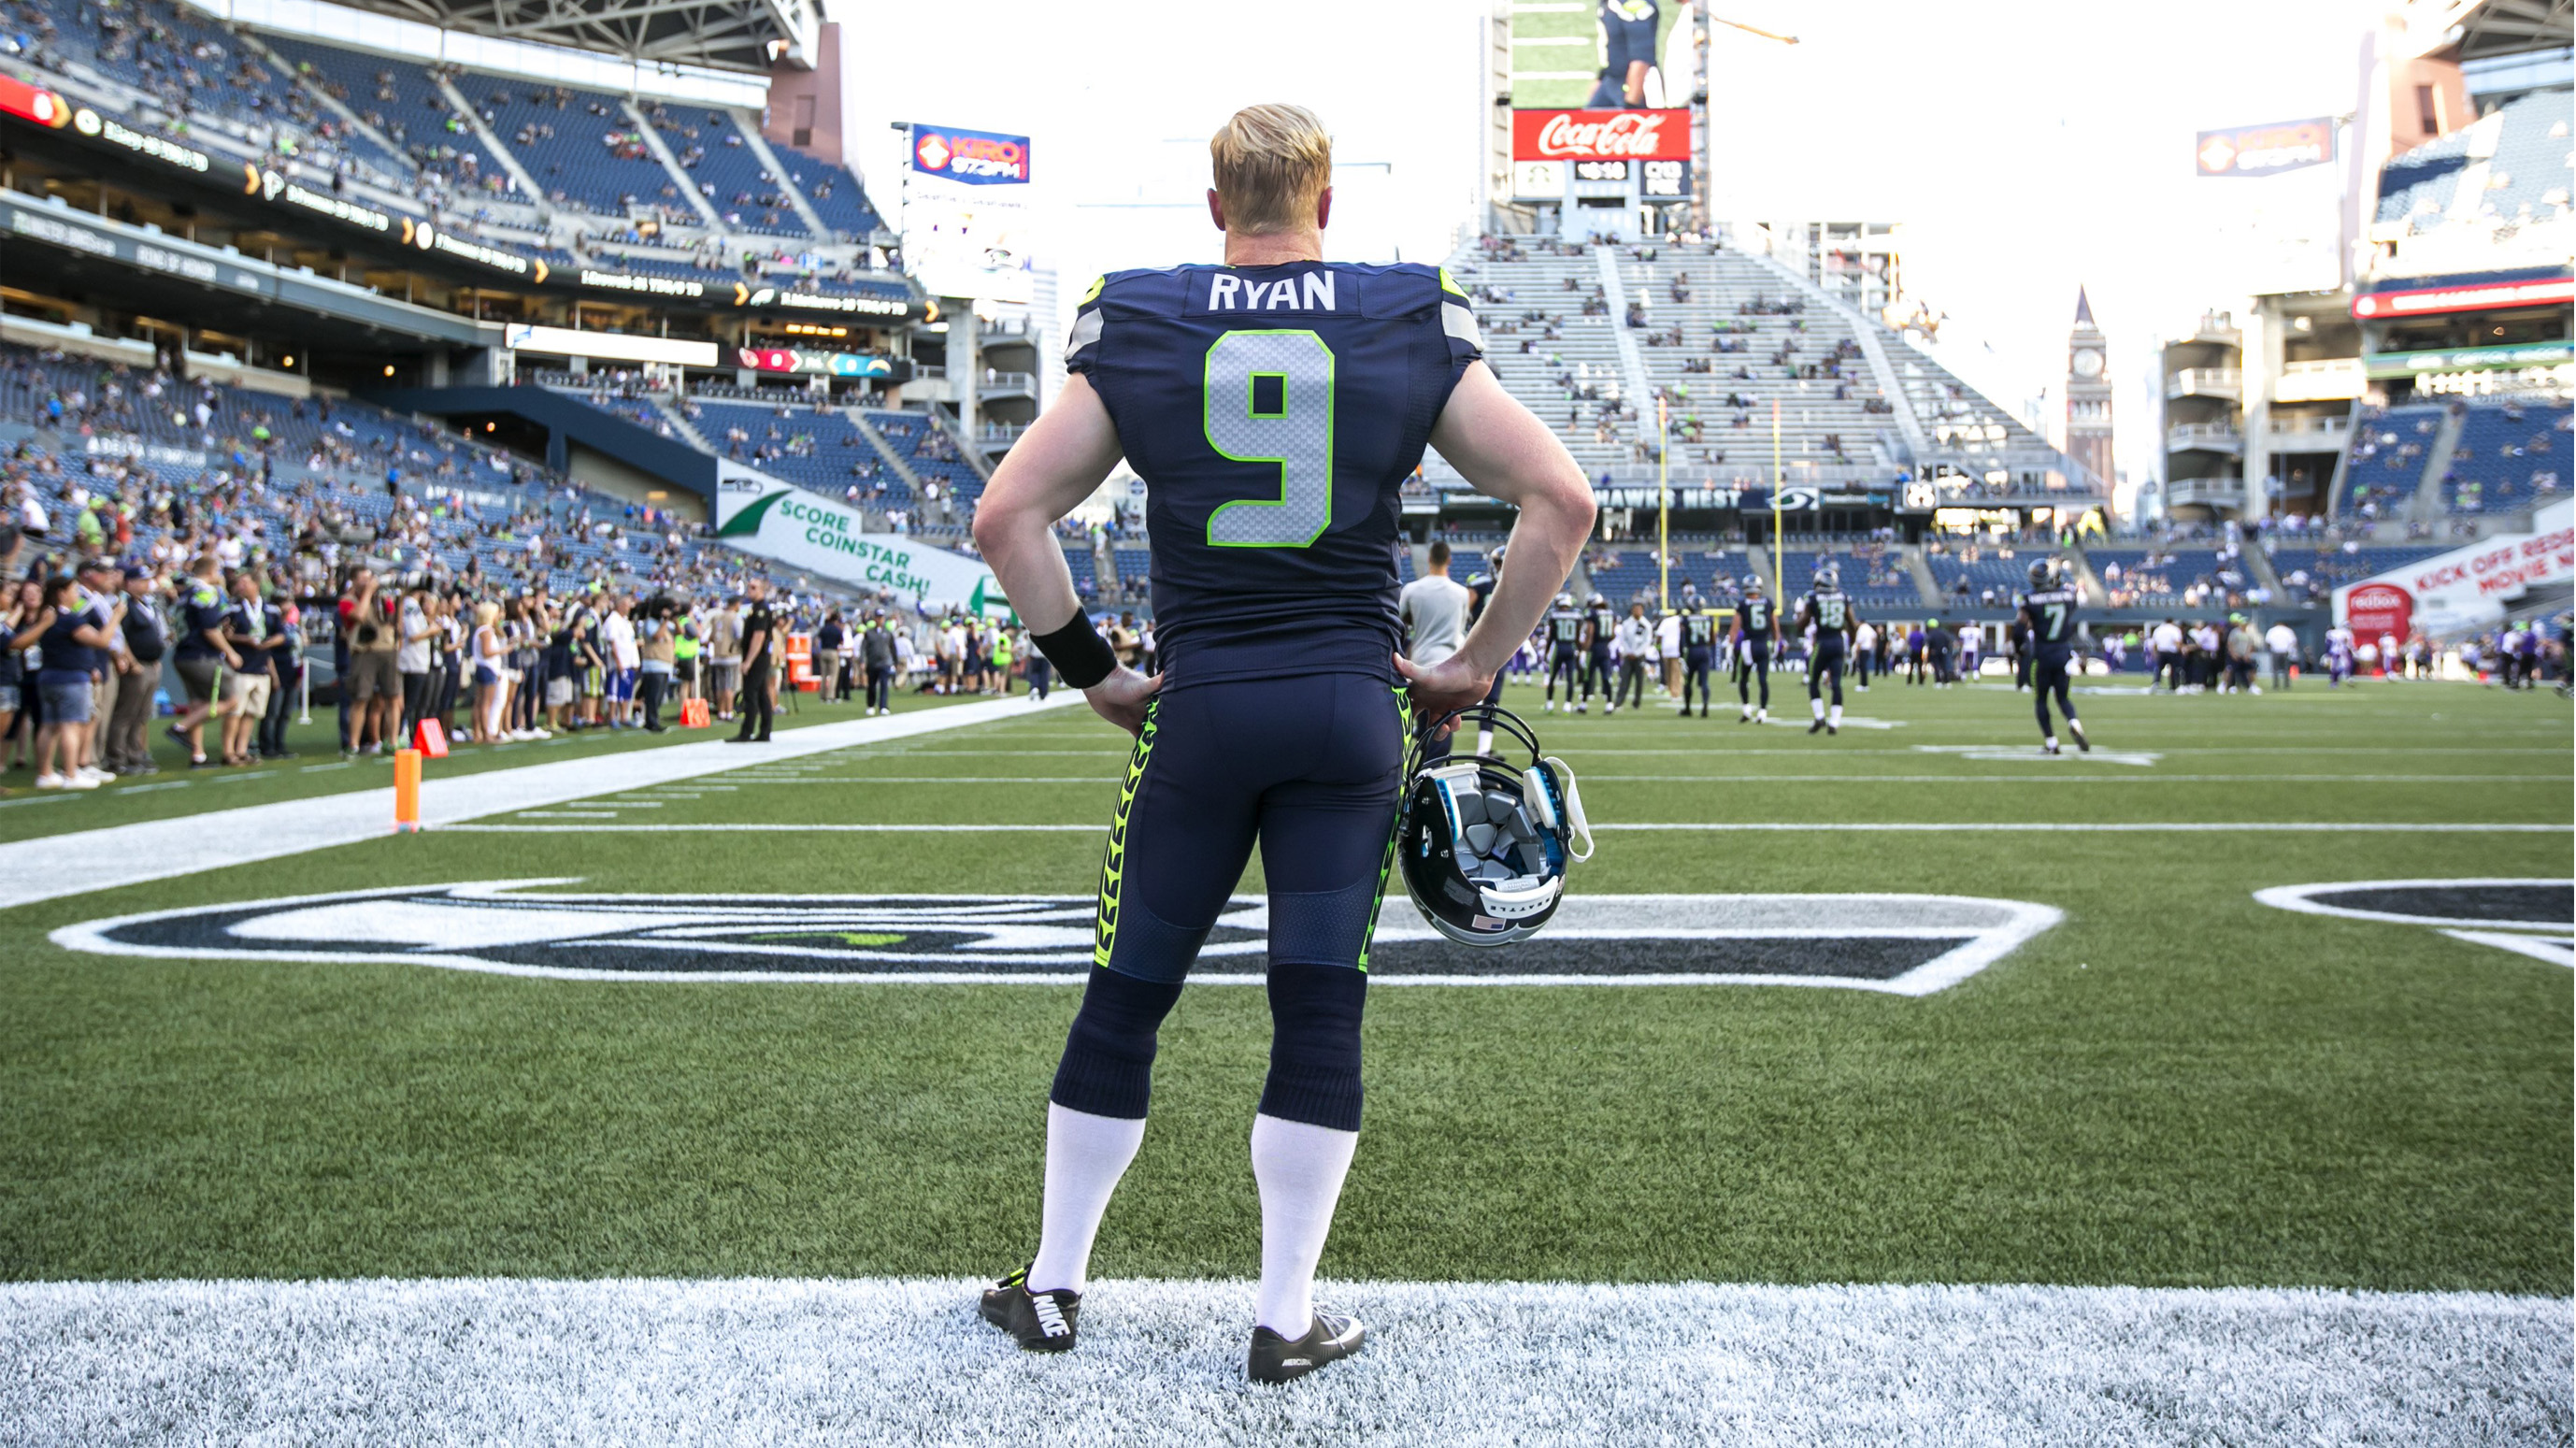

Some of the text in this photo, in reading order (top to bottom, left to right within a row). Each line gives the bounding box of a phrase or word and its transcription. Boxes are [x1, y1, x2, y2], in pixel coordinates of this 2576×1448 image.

[951, 136, 1020, 164] KIRO
[1209, 270, 1336, 311] RYAN
[1204, 329, 1335, 548] 9
[1682, 488, 1742, 509] NEST
[780, 499, 850, 533] SCORE
[806, 526, 910, 569] COINSTAR
[866, 564, 931, 597] CASH!
[2415, 563, 2467, 592] KICK
[2471, 547, 2514, 575] OFF
[2479, 558, 2549, 595] MOVIE
[1750, 604, 1767, 630] 6
[1818, 597, 1846, 629] 18
[2351, 593, 2400, 609] redbox
[1555, 619, 1578, 642] 10
[1598, 614, 1614, 638] 11
[1688, 620, 1711, 645] 14
[2044, 603, 2067, 641] 7
[1033, 1295, 1071, 1338] NIKE
